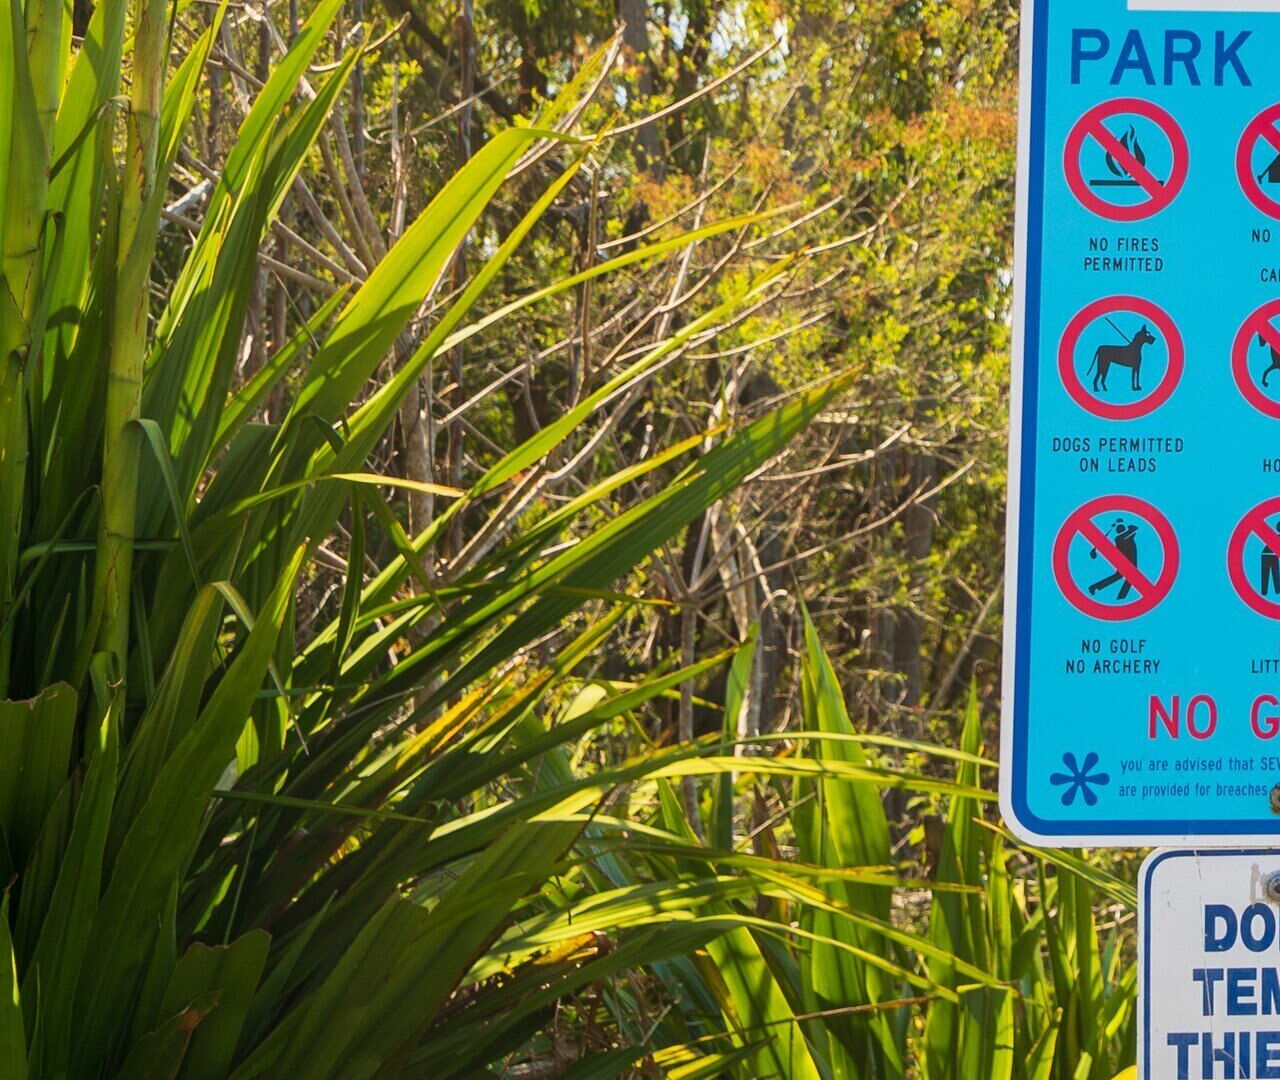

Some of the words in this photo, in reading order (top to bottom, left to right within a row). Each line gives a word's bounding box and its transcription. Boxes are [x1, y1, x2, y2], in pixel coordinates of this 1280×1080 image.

[1071, 29, 1252, 86] PARK
[1252, 229, 1270, 242] NO
[1090, 238, 1108, 251] NO
[1118, 238, 1158, 251] FIRES
[1085, 258, 1162, 271] PERMITTED
[1053, 438, 1090, 452] DOGS
[1099, 438, 1183, 452] PERMITTED
[1080, 458, 1098, 472] ON
[1109, 458, 1155, 472] LEADS
[1082, 639, 1100, 653] NO
[1110, 639, 1146, 653] GOLF
[1066, 660, 1084, 673] NO
[1094, 660, 1160, 673] ARCHERY
[1150, 695, 1217, 739] NO
[1121, 760, 1142, 774] you
[1149, 760, 1168, 771] are
[1175, 758, 1222, 771] advised
[1229, 757, 1254, 770] that
[1119, 786, 1136, 796] are
[1142, 783, 1189, 799] provided
[1196, 783, 1210, 796] for
[1217, 783, 1267, 796] breaches
